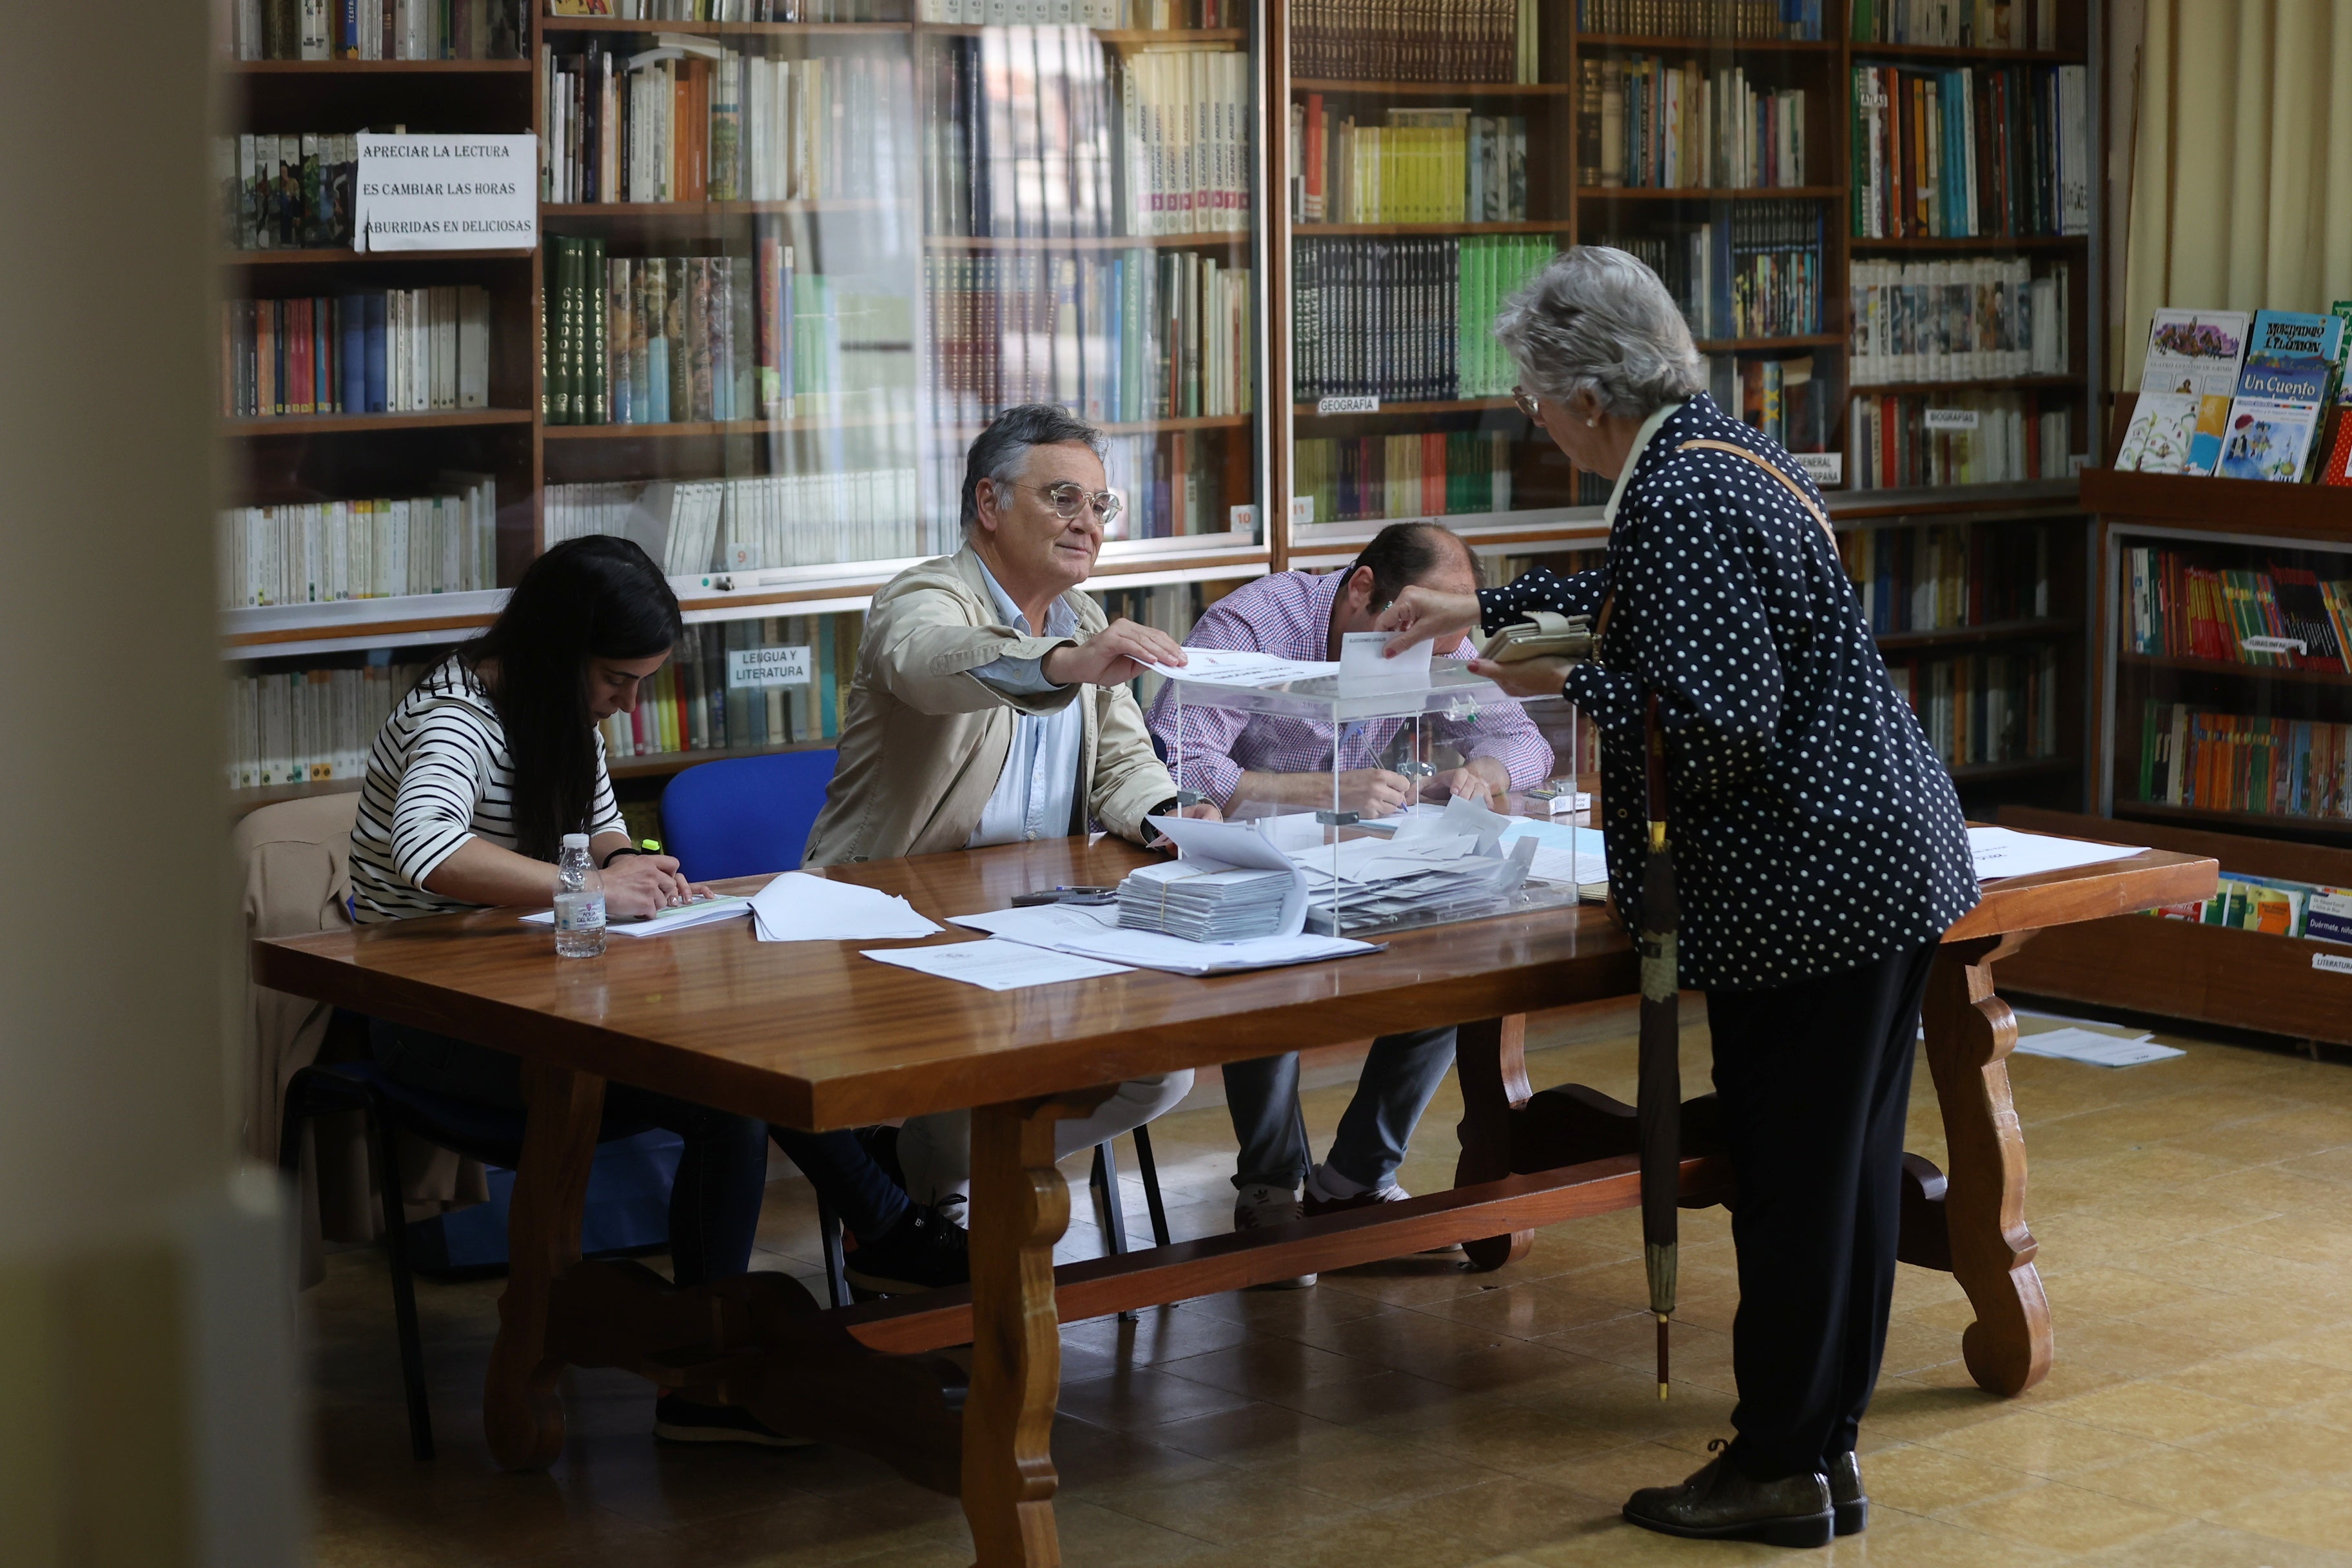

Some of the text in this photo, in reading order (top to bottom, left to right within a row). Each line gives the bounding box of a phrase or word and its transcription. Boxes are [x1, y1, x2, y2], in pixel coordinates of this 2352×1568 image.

[363, 145, 510, 158] APRECIAR LA LECTURA
[363, 182, 516, 195] ES CAMBIAR LAS HORAS
[363, 220, 531, 234] ABURRIDAS EN DELICIOSAS
[558, 288, 571, 375] CORDOBA
[575, 288, 583, 376] CORDOBA
[2244, 374, 2264, 389] Un
[2266, 377, 2316, 396] Cuento
[1321, 397, 1373, 411] GEOGRAFÍA
[1930, 411, 1975, 424] BIOGRAFÍAS
[1797, 457, 1831, 467] GENERAL
[1810, 471, 1838, 482] ESPAÑA
[1237, 512, 1251, 524] 10
[738, 551, 746, 563] 9
[743, 650, 796, 663] LENGUA Y
[736, 665, 803, 680] LITERATURA
[2309, 918, 2340, 933] Duérmete,
